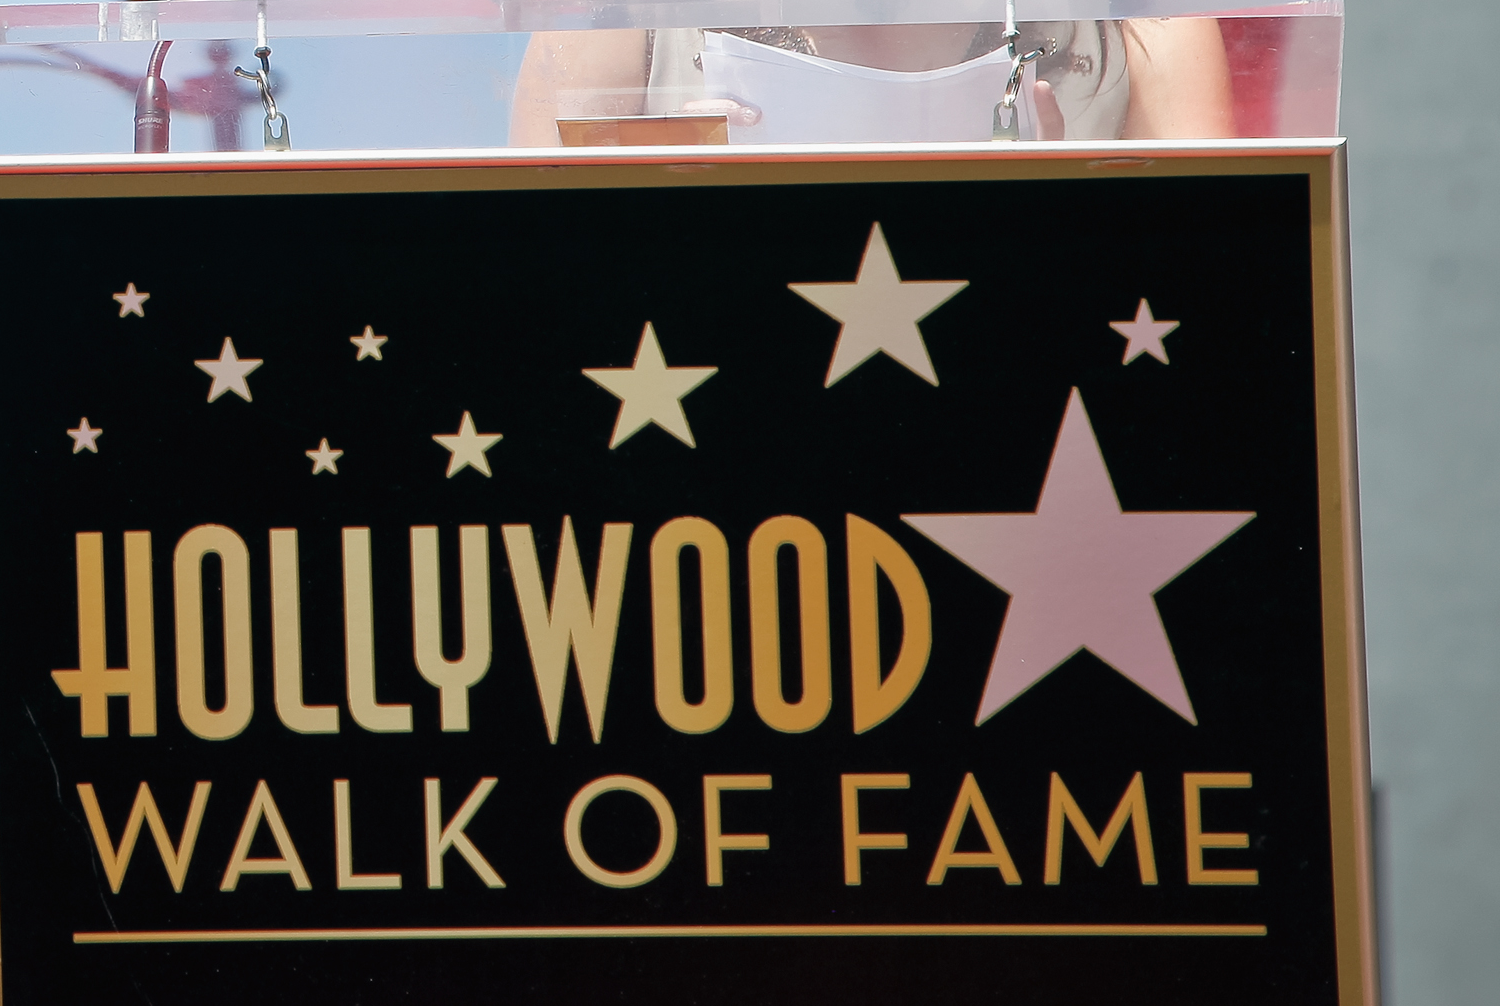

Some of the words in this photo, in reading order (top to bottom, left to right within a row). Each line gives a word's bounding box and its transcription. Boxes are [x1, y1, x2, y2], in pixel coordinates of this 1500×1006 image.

[50, 512, 933, 745] HOLLYWOOD
[76, 776, 507, 894] WALK
[563, 772, 773, 889] OF
[840, 771, 1259, 886] FAME
